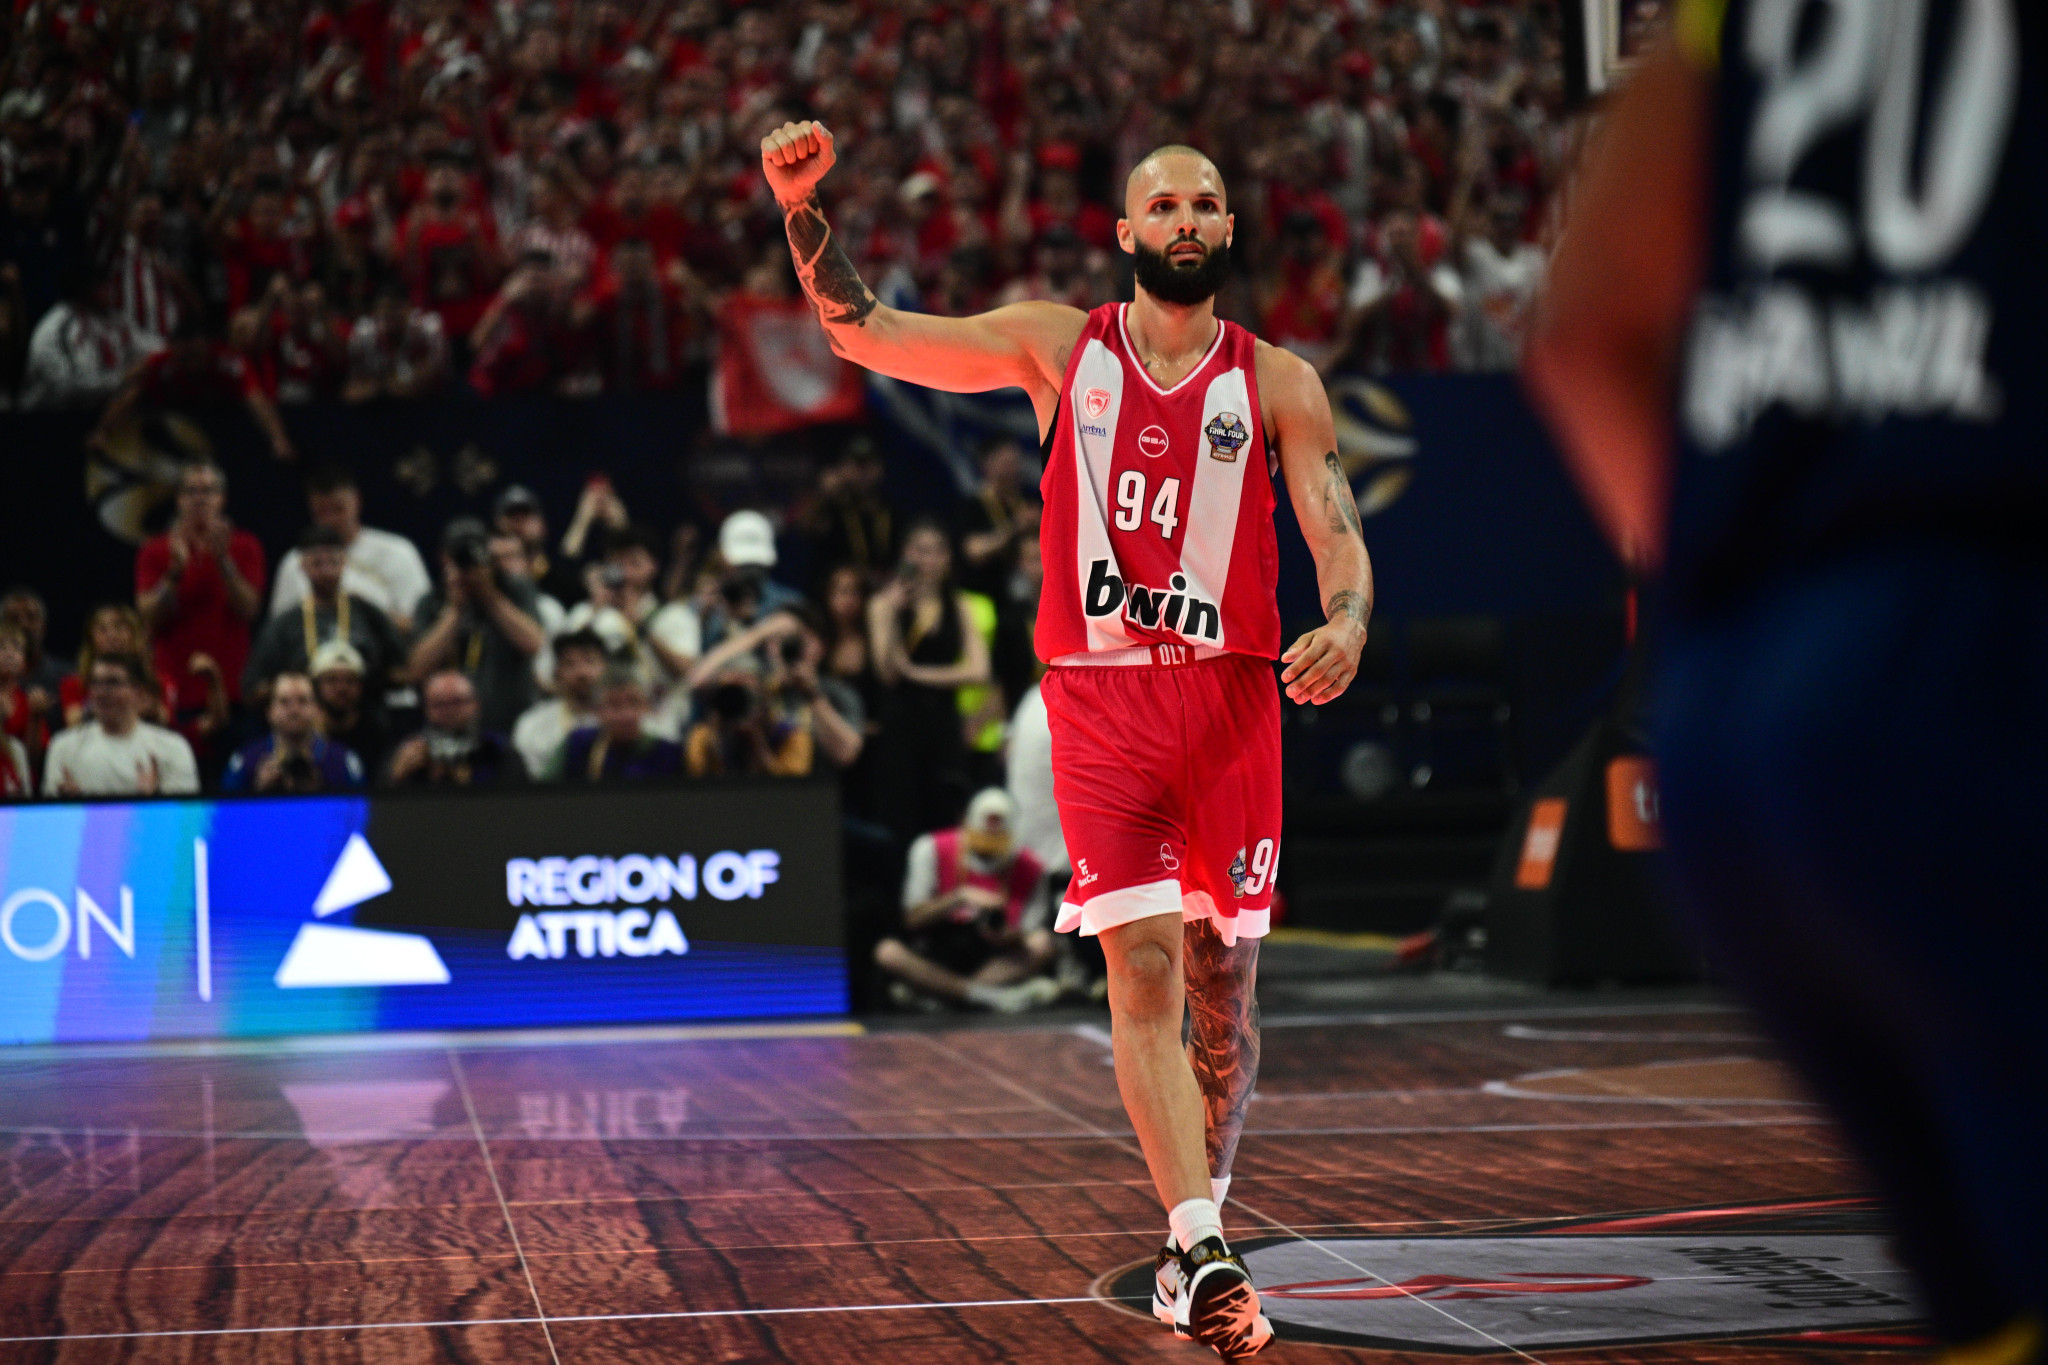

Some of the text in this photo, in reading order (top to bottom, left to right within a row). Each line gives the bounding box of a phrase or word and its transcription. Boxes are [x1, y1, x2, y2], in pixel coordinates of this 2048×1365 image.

[1141, 436, 1167, 446] GSA
[1227, 429, 1245, 440] FOUR
[1115, 470, 1180, 539] 94
[1084, 558, 1220, 640] bwin
[1158, 643, 1186, 666] OLY
[505, 849, 782, 907] REGION OF
[507, 909, 690, 961] ATTICA
